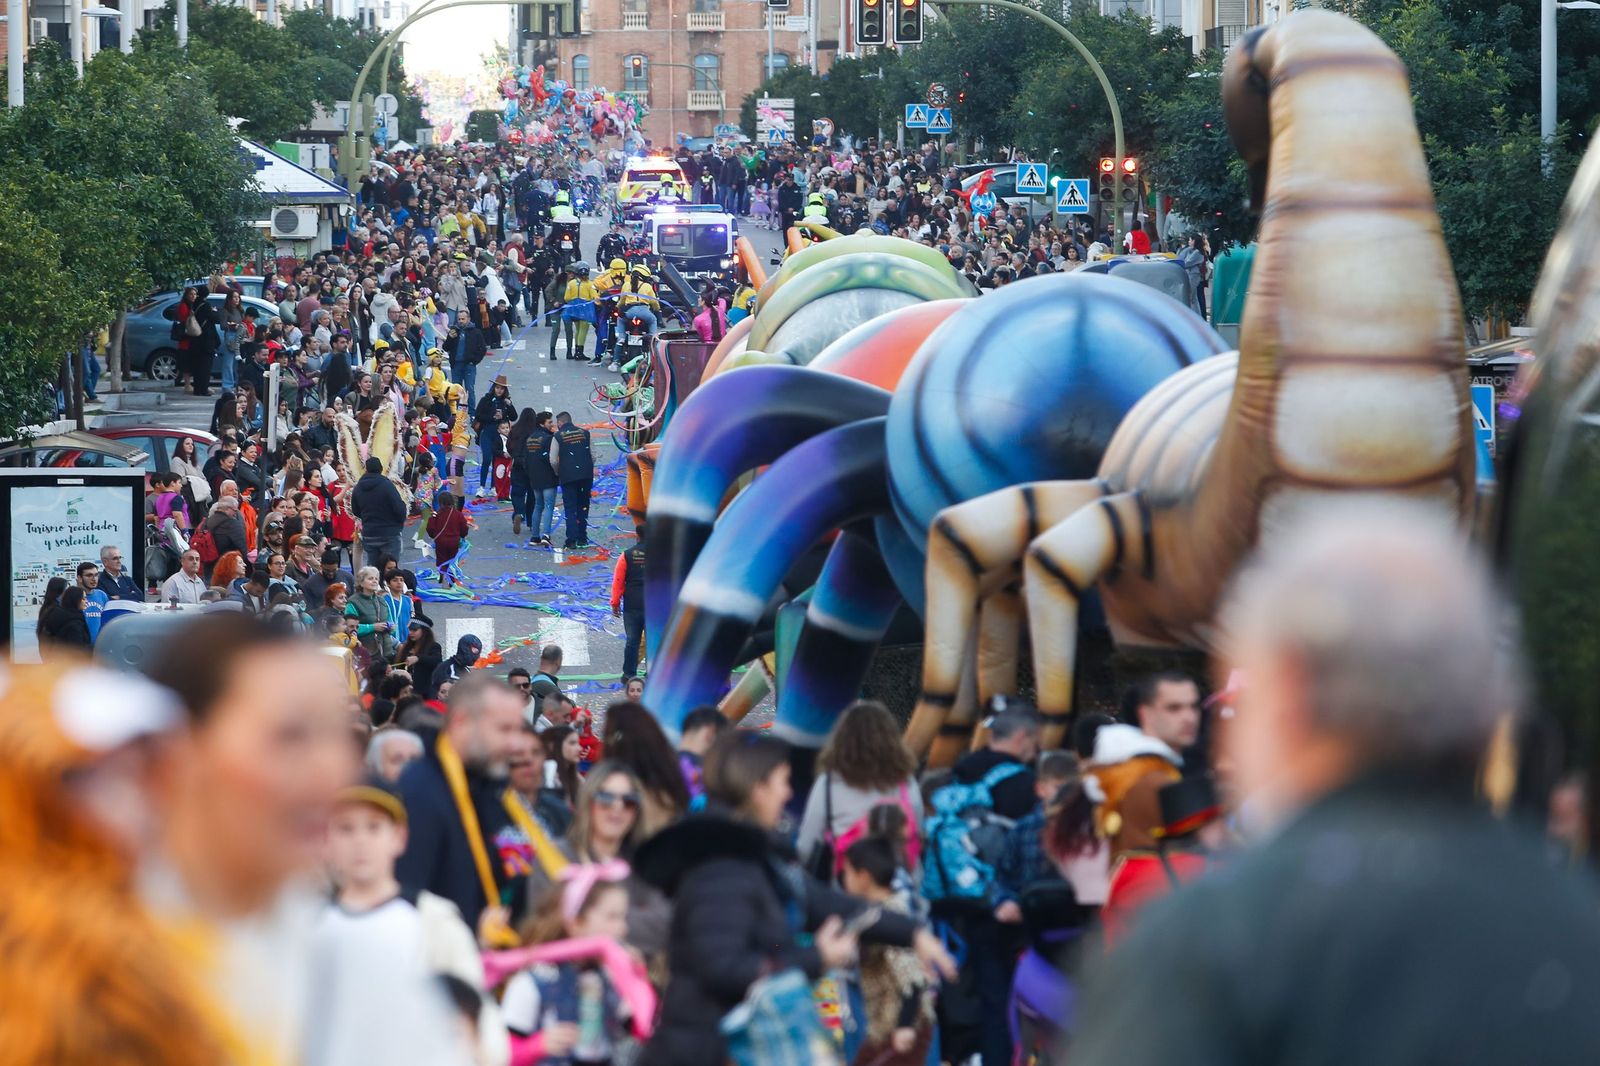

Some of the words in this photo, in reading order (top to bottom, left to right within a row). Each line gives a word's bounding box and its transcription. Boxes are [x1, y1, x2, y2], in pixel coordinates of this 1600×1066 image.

[25, 522, 65, 534] Turismo
[68, 520, 118, 534] reciclador
[44, 540, 51, 550] y
[55, 534, 100, 547] sostenible
